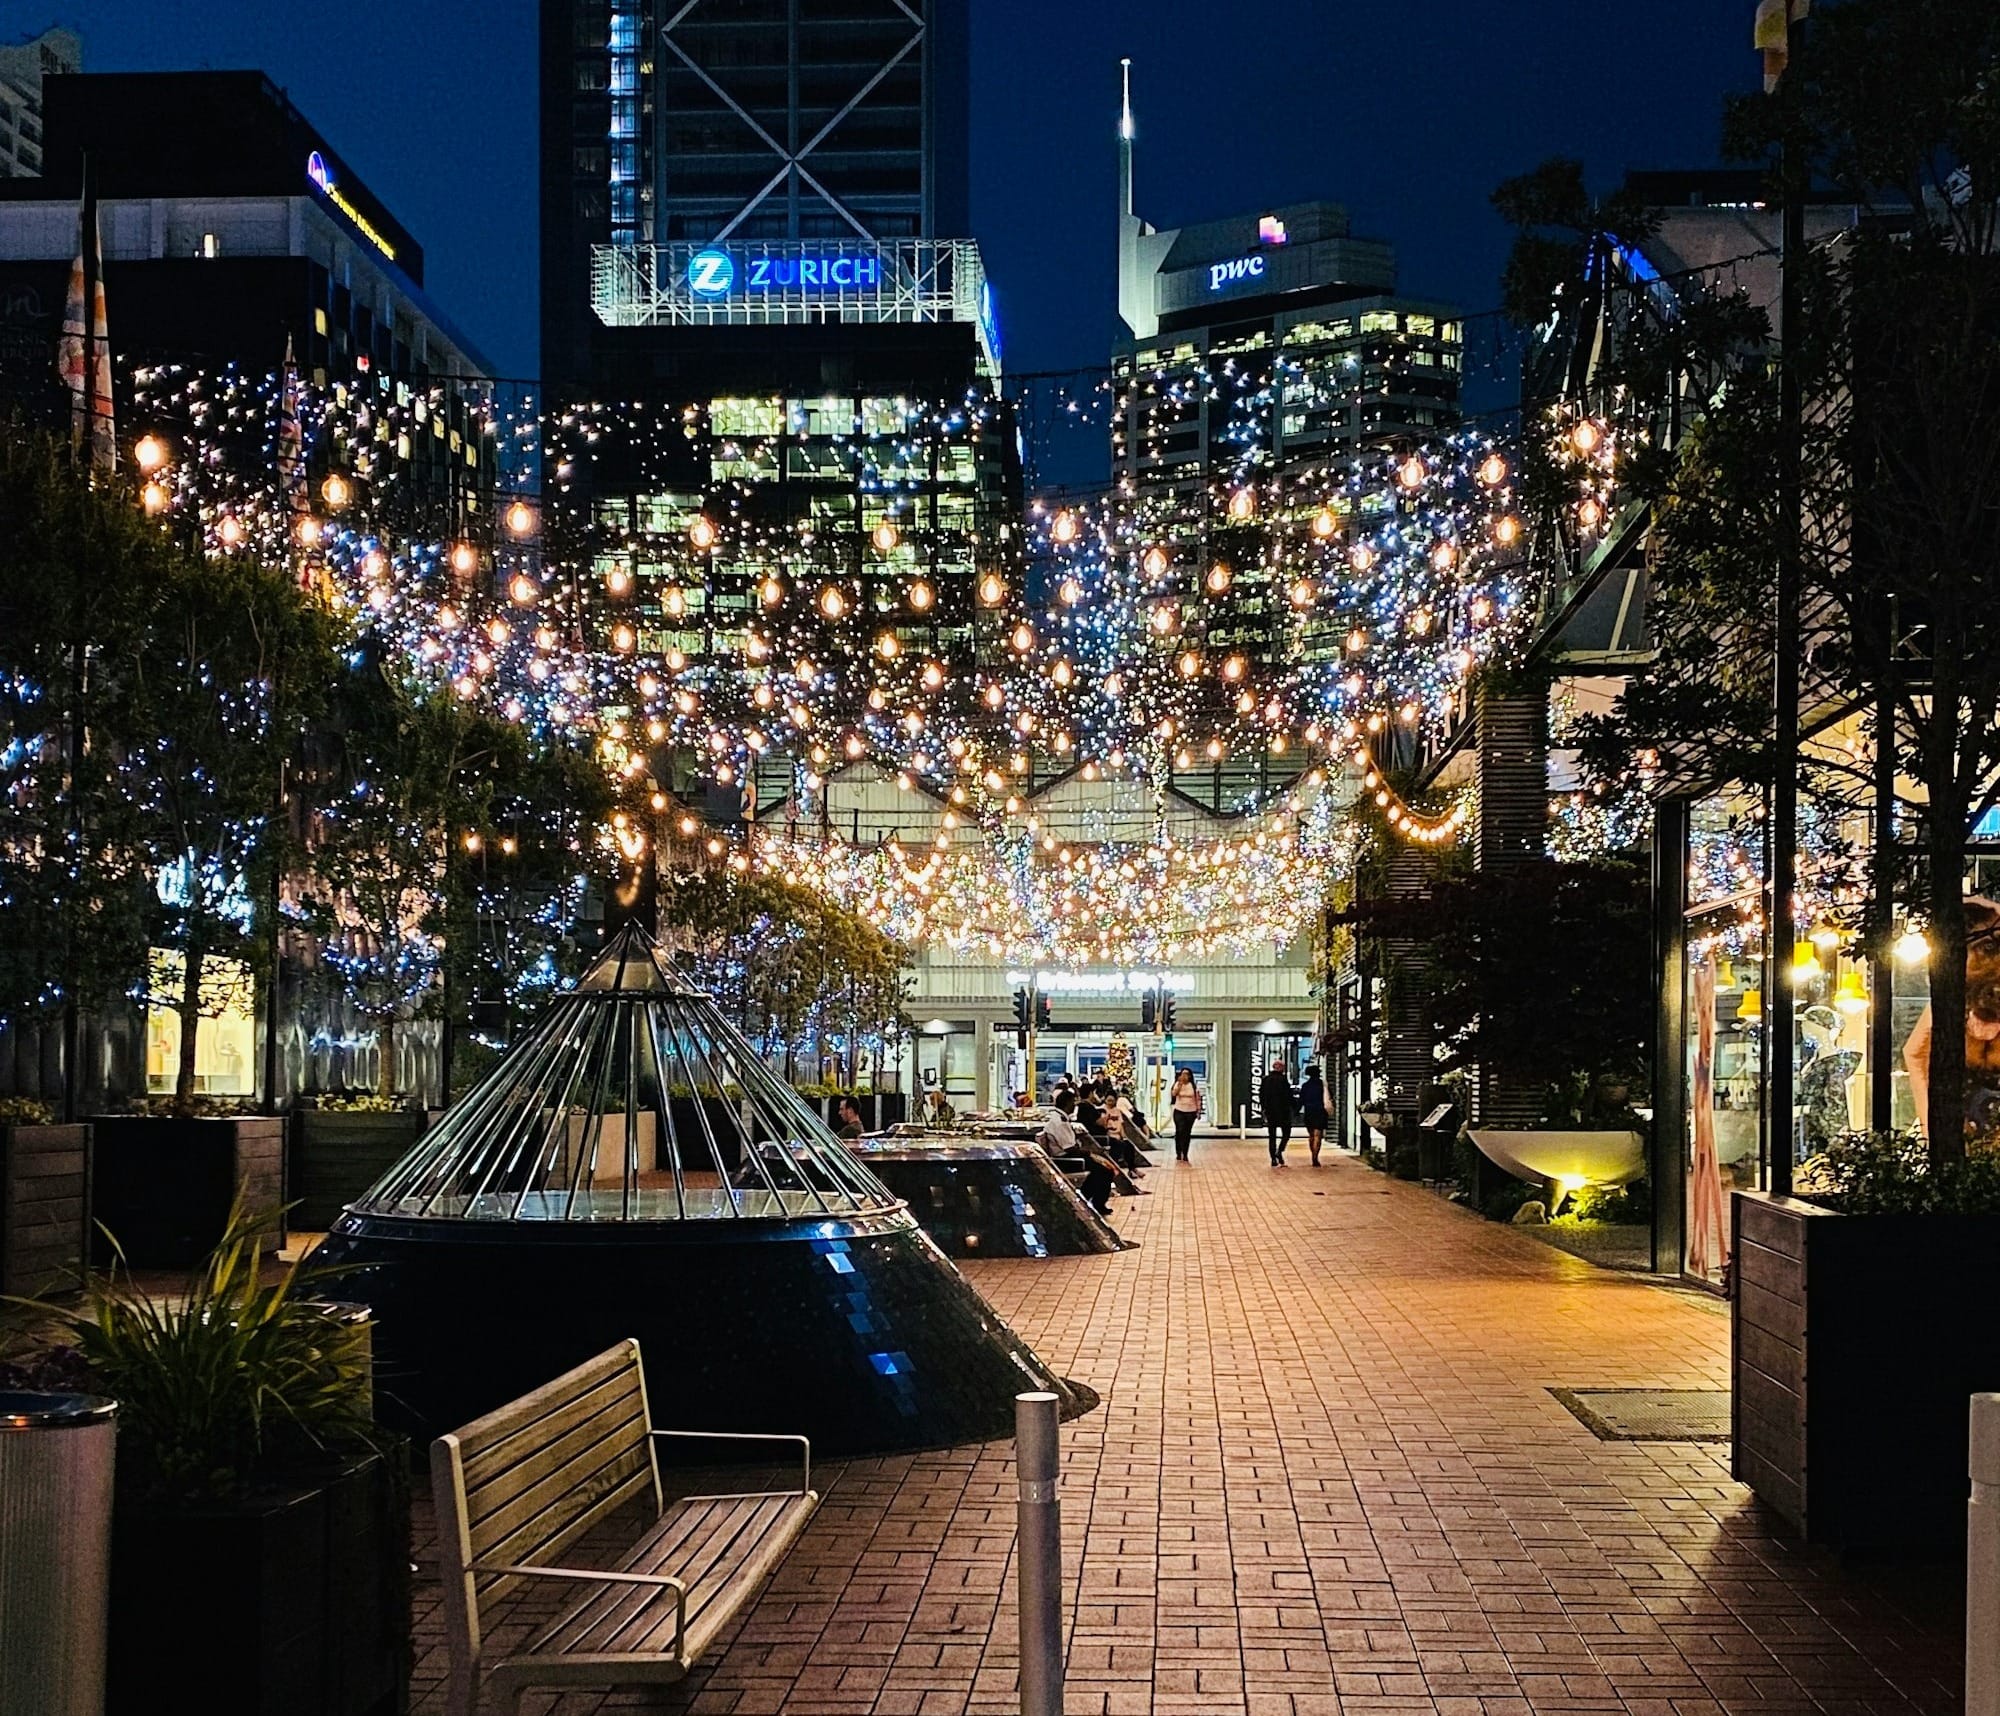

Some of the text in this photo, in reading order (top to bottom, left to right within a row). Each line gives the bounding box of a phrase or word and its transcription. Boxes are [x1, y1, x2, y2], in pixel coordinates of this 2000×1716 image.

[751, 258, 875, 286] ZURICH
[1210, 256, 1264, 290] pwc
[1250, 1041, 1263, 1119] YEAHBOWL
